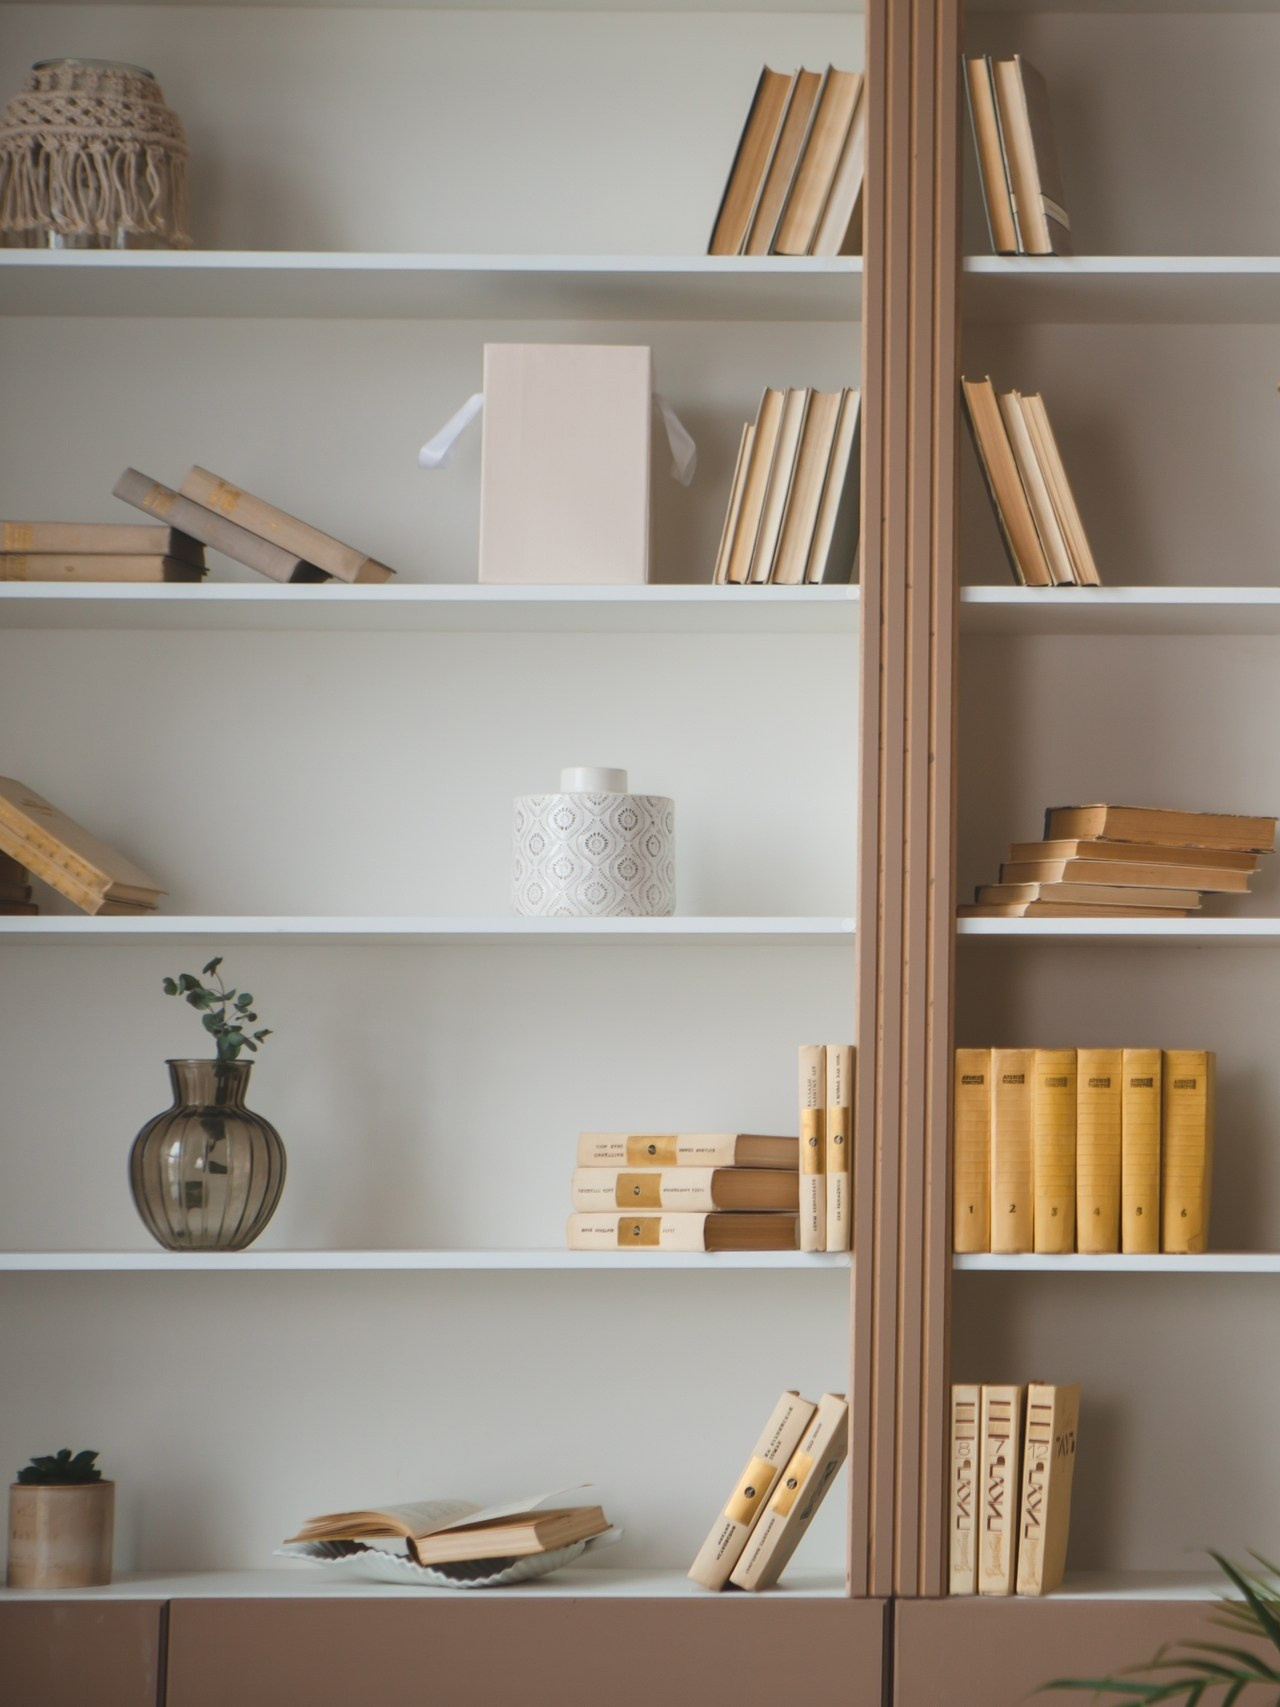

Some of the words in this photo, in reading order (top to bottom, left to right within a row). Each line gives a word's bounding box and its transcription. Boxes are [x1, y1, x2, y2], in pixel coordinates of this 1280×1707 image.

[968, 1205, 974, 1214] 1
[1008, 1204, 1017, 1214] 2
[1093, 1207, 1101, 1216] 4
[1135, 1206, 1143, 1216] 5
[1180, 1208, 1188, 1218] 6
[958, 1442, 971, 1456] 8
[994, 1439, 1006, 1454] 7
[1028, 1445, 1050, 1461] 12
